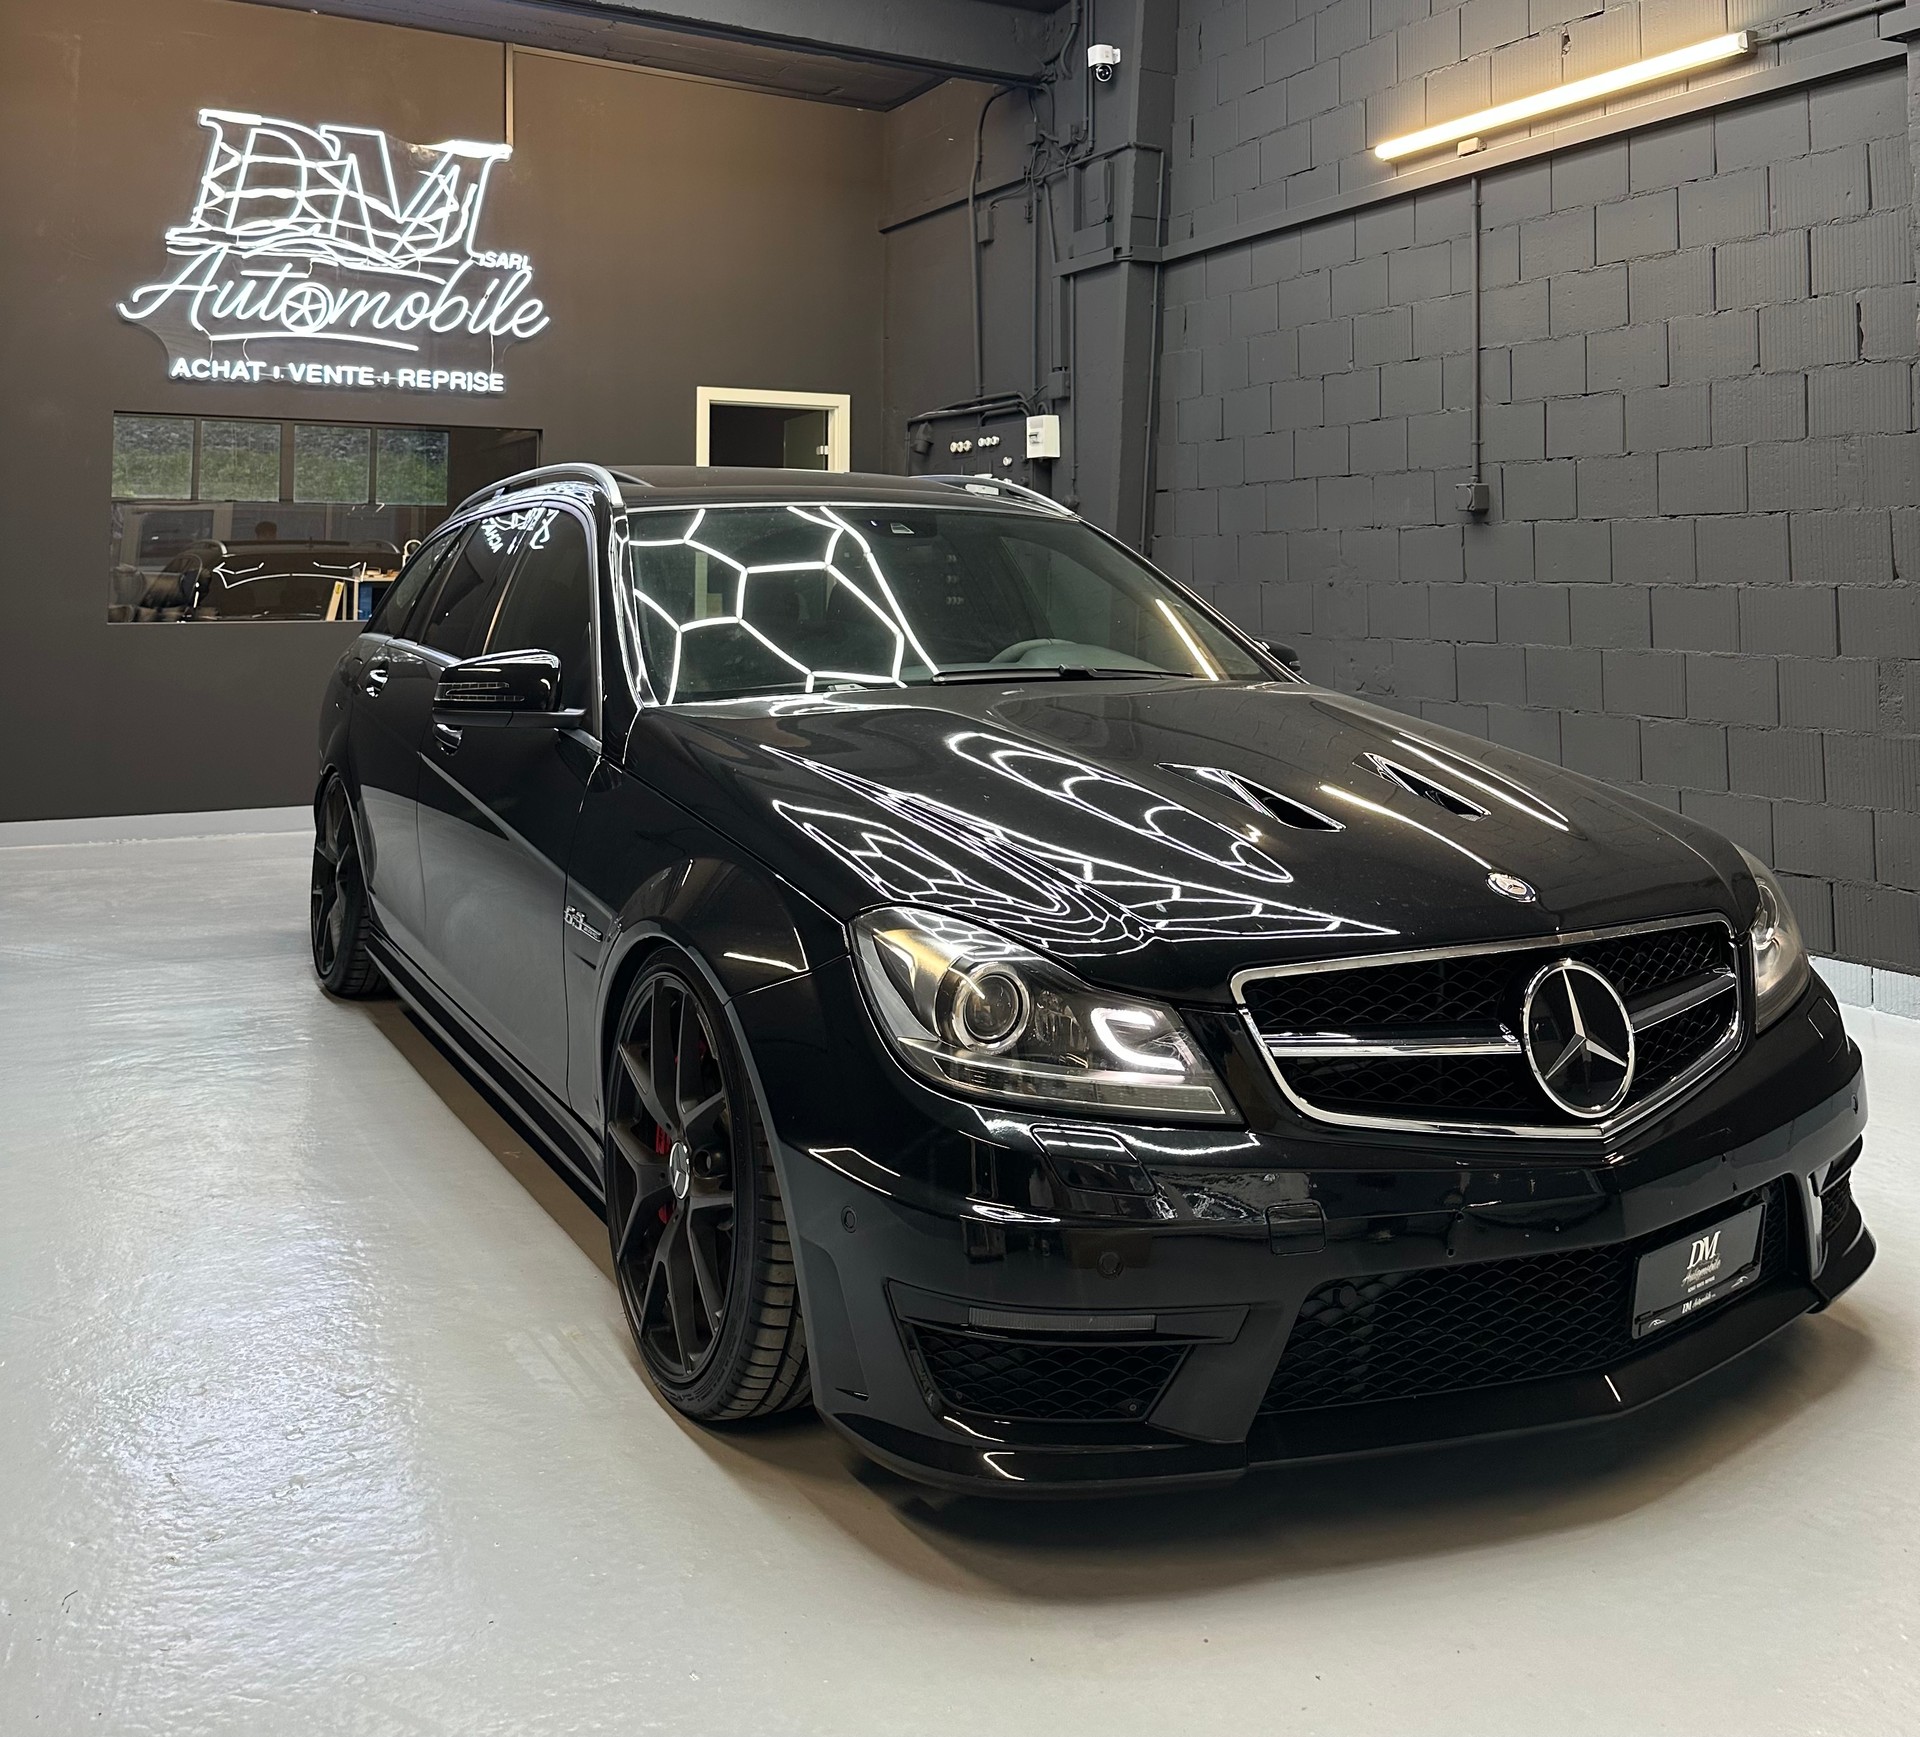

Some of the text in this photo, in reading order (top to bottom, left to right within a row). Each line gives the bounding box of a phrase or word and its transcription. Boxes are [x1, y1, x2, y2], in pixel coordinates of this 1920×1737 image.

[165, 108, 513, 258] DM
[484, 251, 533, 271] SARL
[116, 243, 550, 339] Automobile
[171, 357, 505, 393] ACHAT VENTE REPRISE
[1686, 1230, 1721, 1270] DM
